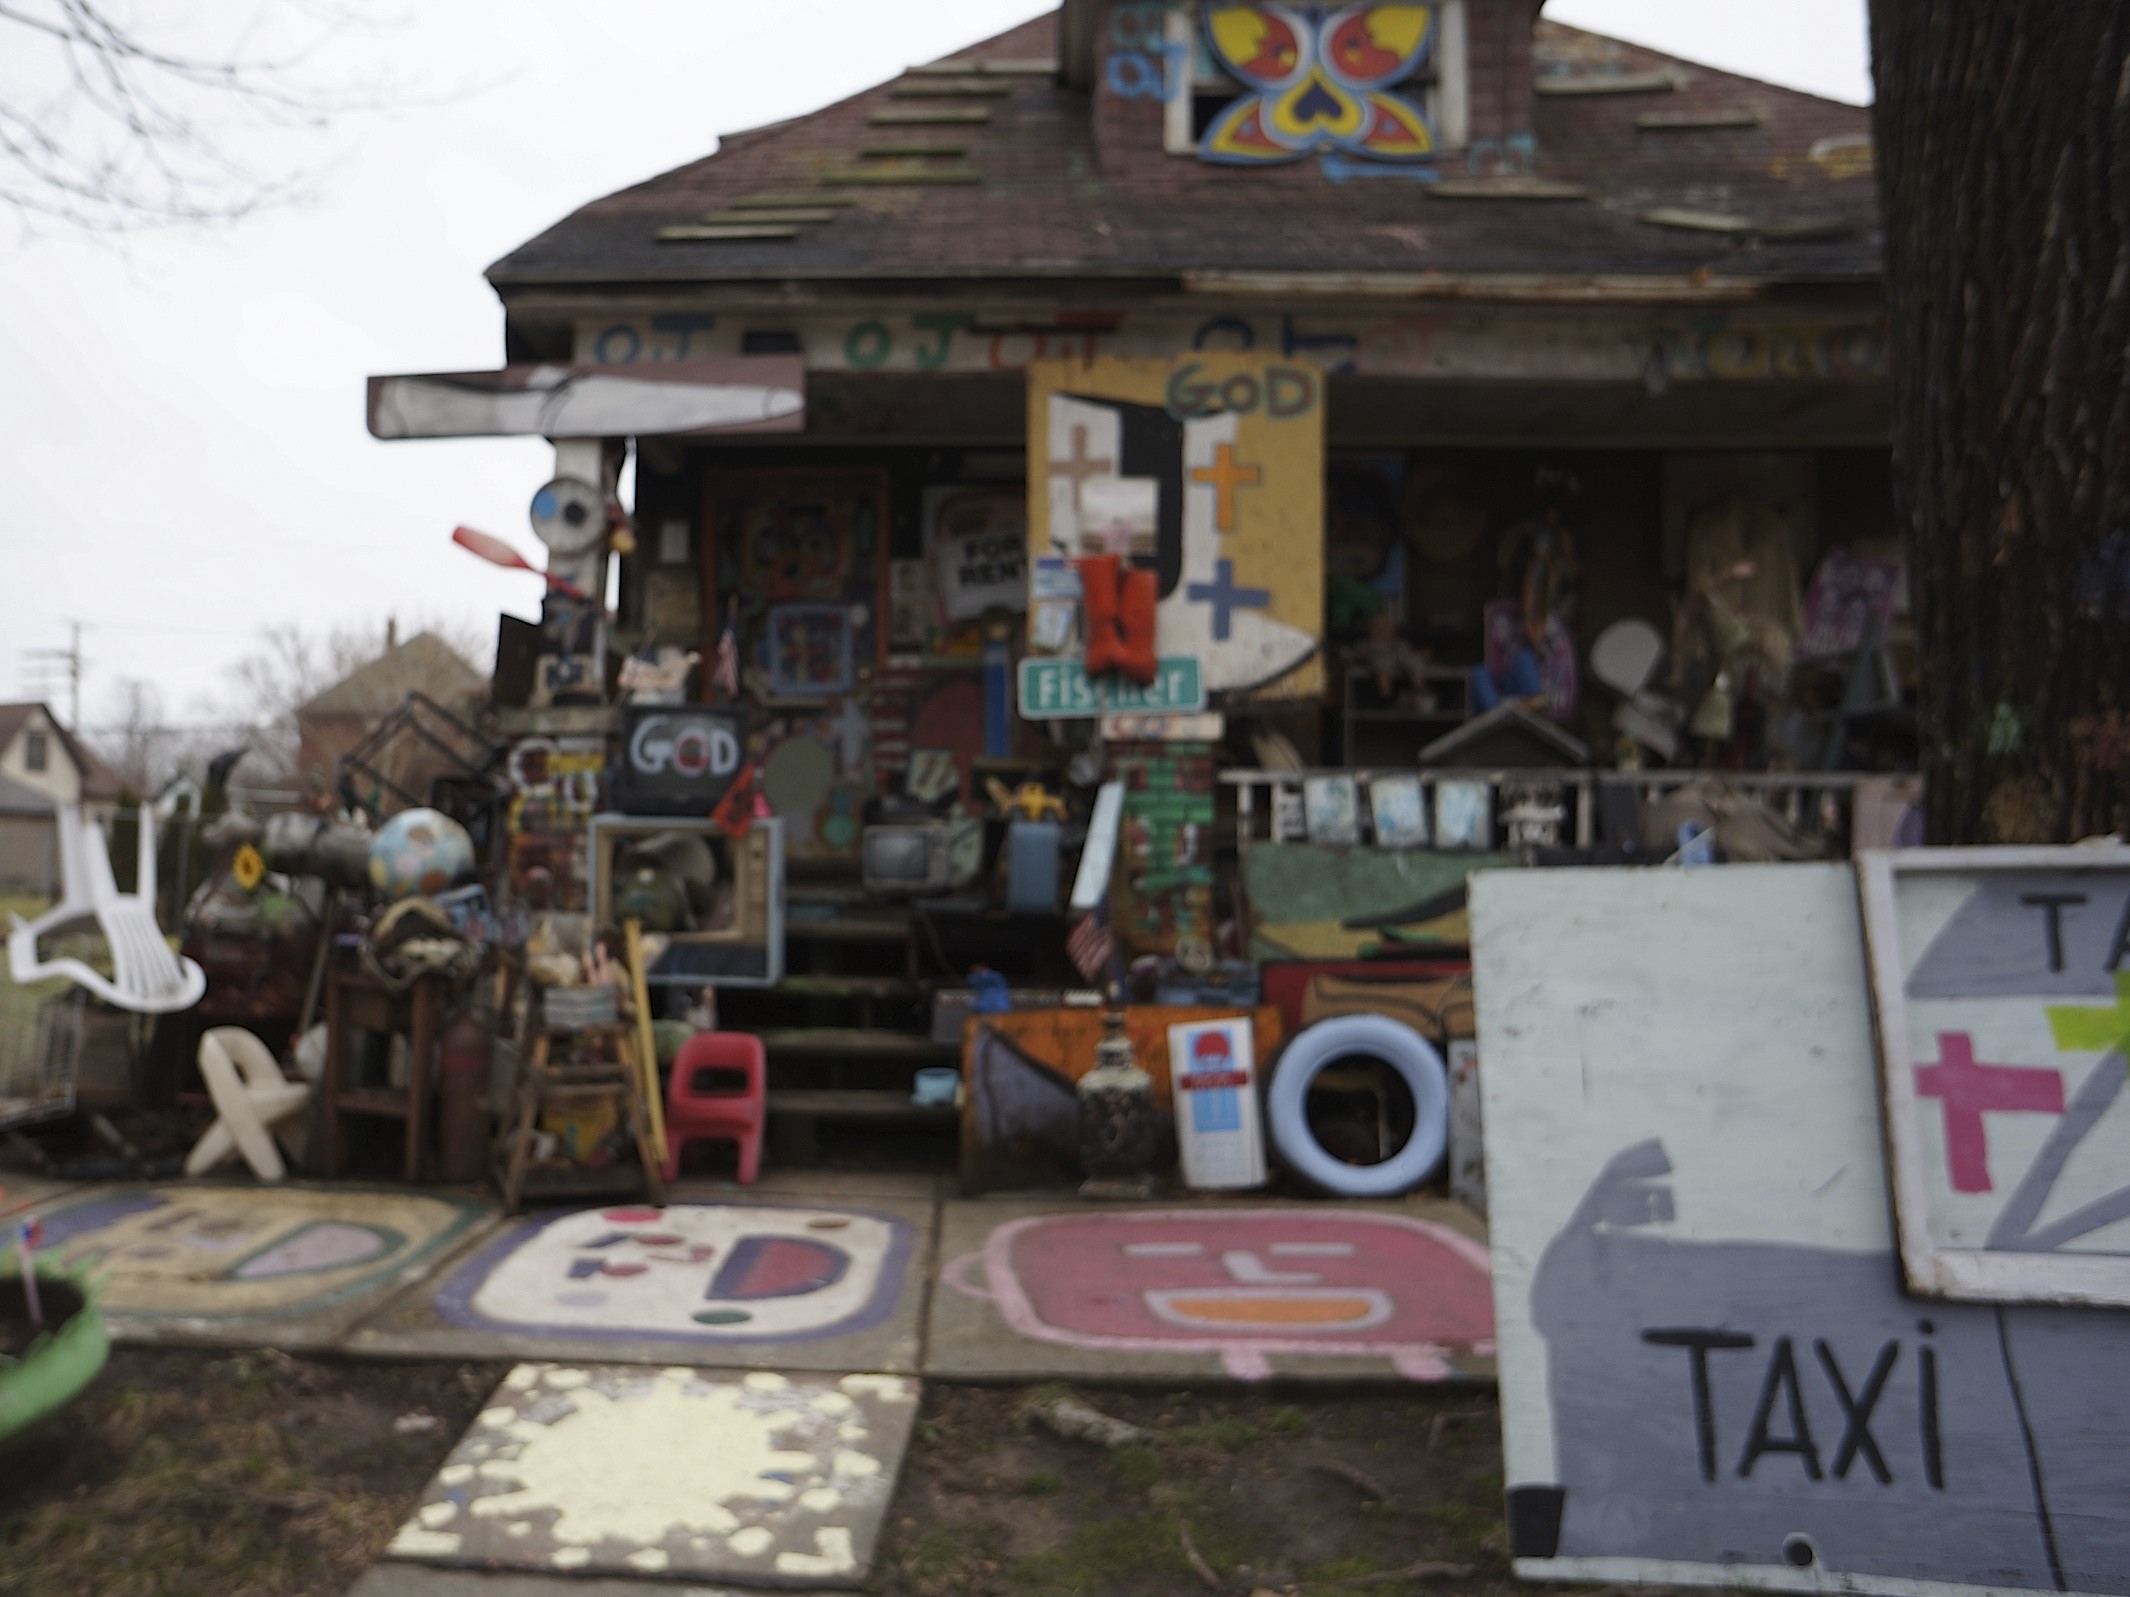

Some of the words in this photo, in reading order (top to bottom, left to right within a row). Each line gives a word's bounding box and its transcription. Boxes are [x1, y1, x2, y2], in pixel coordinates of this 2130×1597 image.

[1164, 362, 1317, 422] GOD
[964, 535, 1021, 560] FOR
[630, 714, 741, 777] GOD
